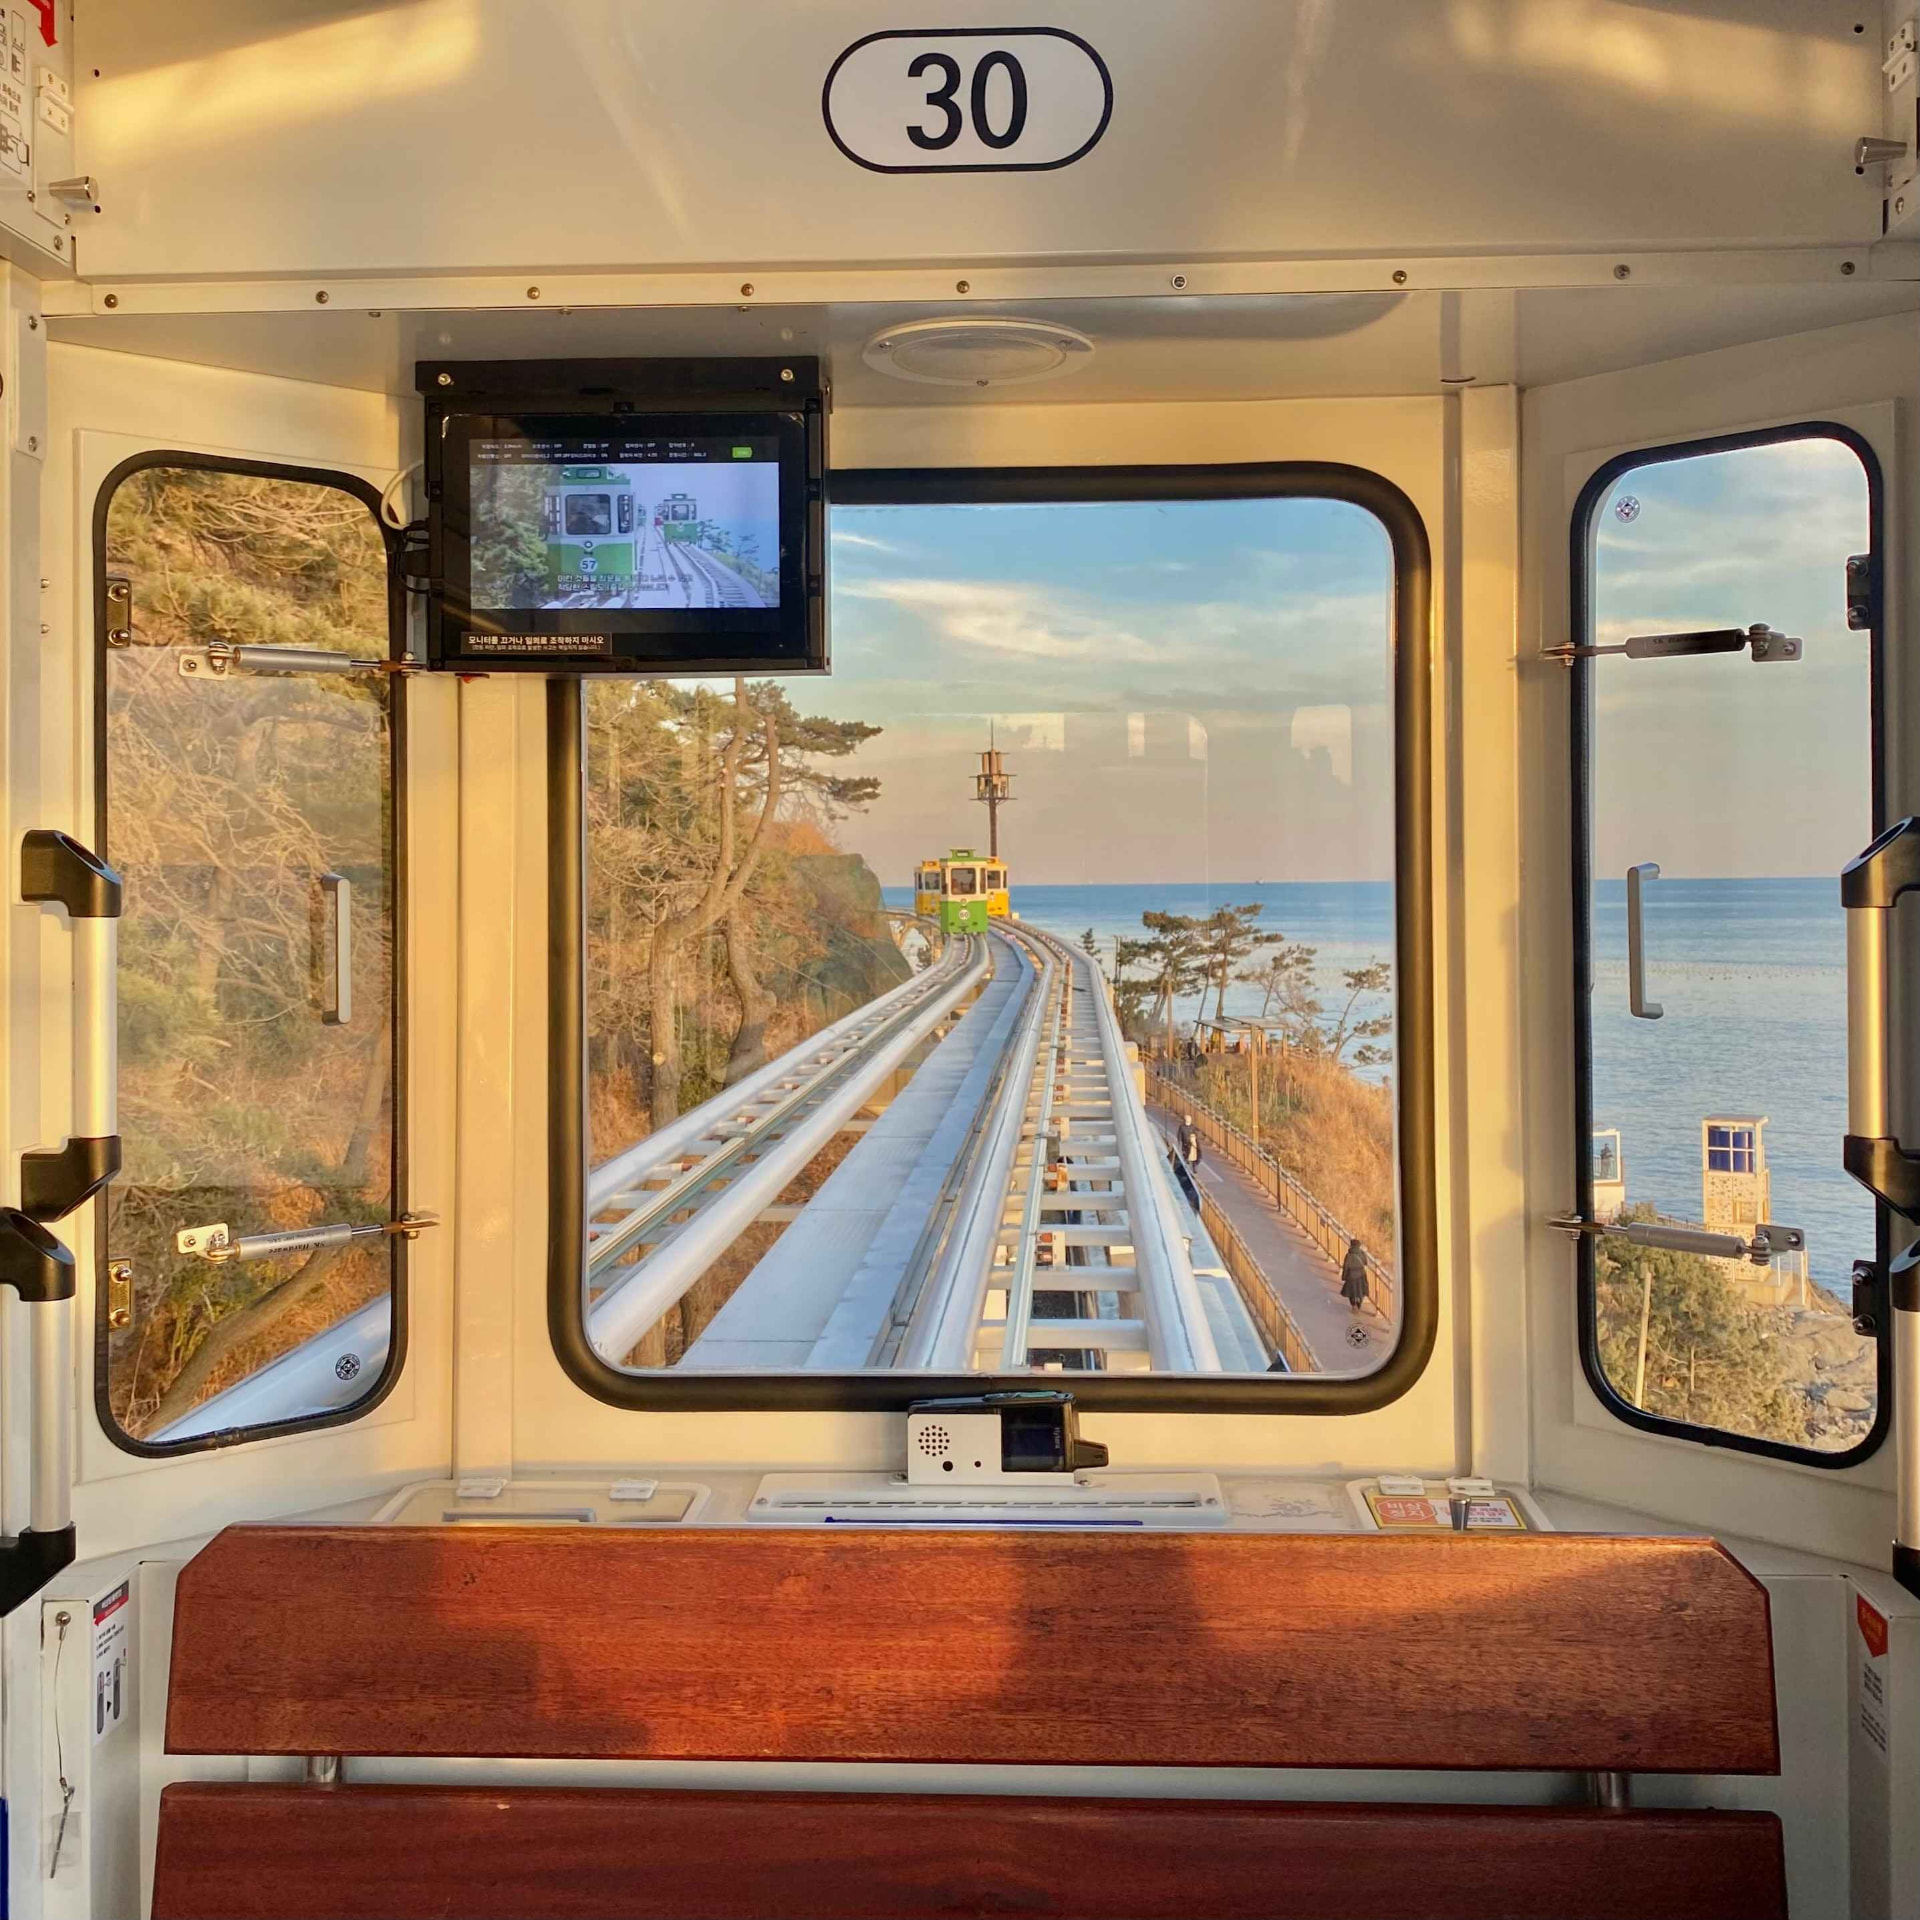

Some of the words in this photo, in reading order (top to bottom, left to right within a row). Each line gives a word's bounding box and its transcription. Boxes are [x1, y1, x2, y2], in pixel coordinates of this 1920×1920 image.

[906, 51, 1027, 150] 30
[581, 560, 597, 570] 57
[468, 635, 499, 645] 모니터를
[500, 635, 523, 645] 끄거나
[525, 635, 548, 645] 임의로
[550, 635, 580, 645] 조작하지
[581, 635, 605, 644] 마시오
